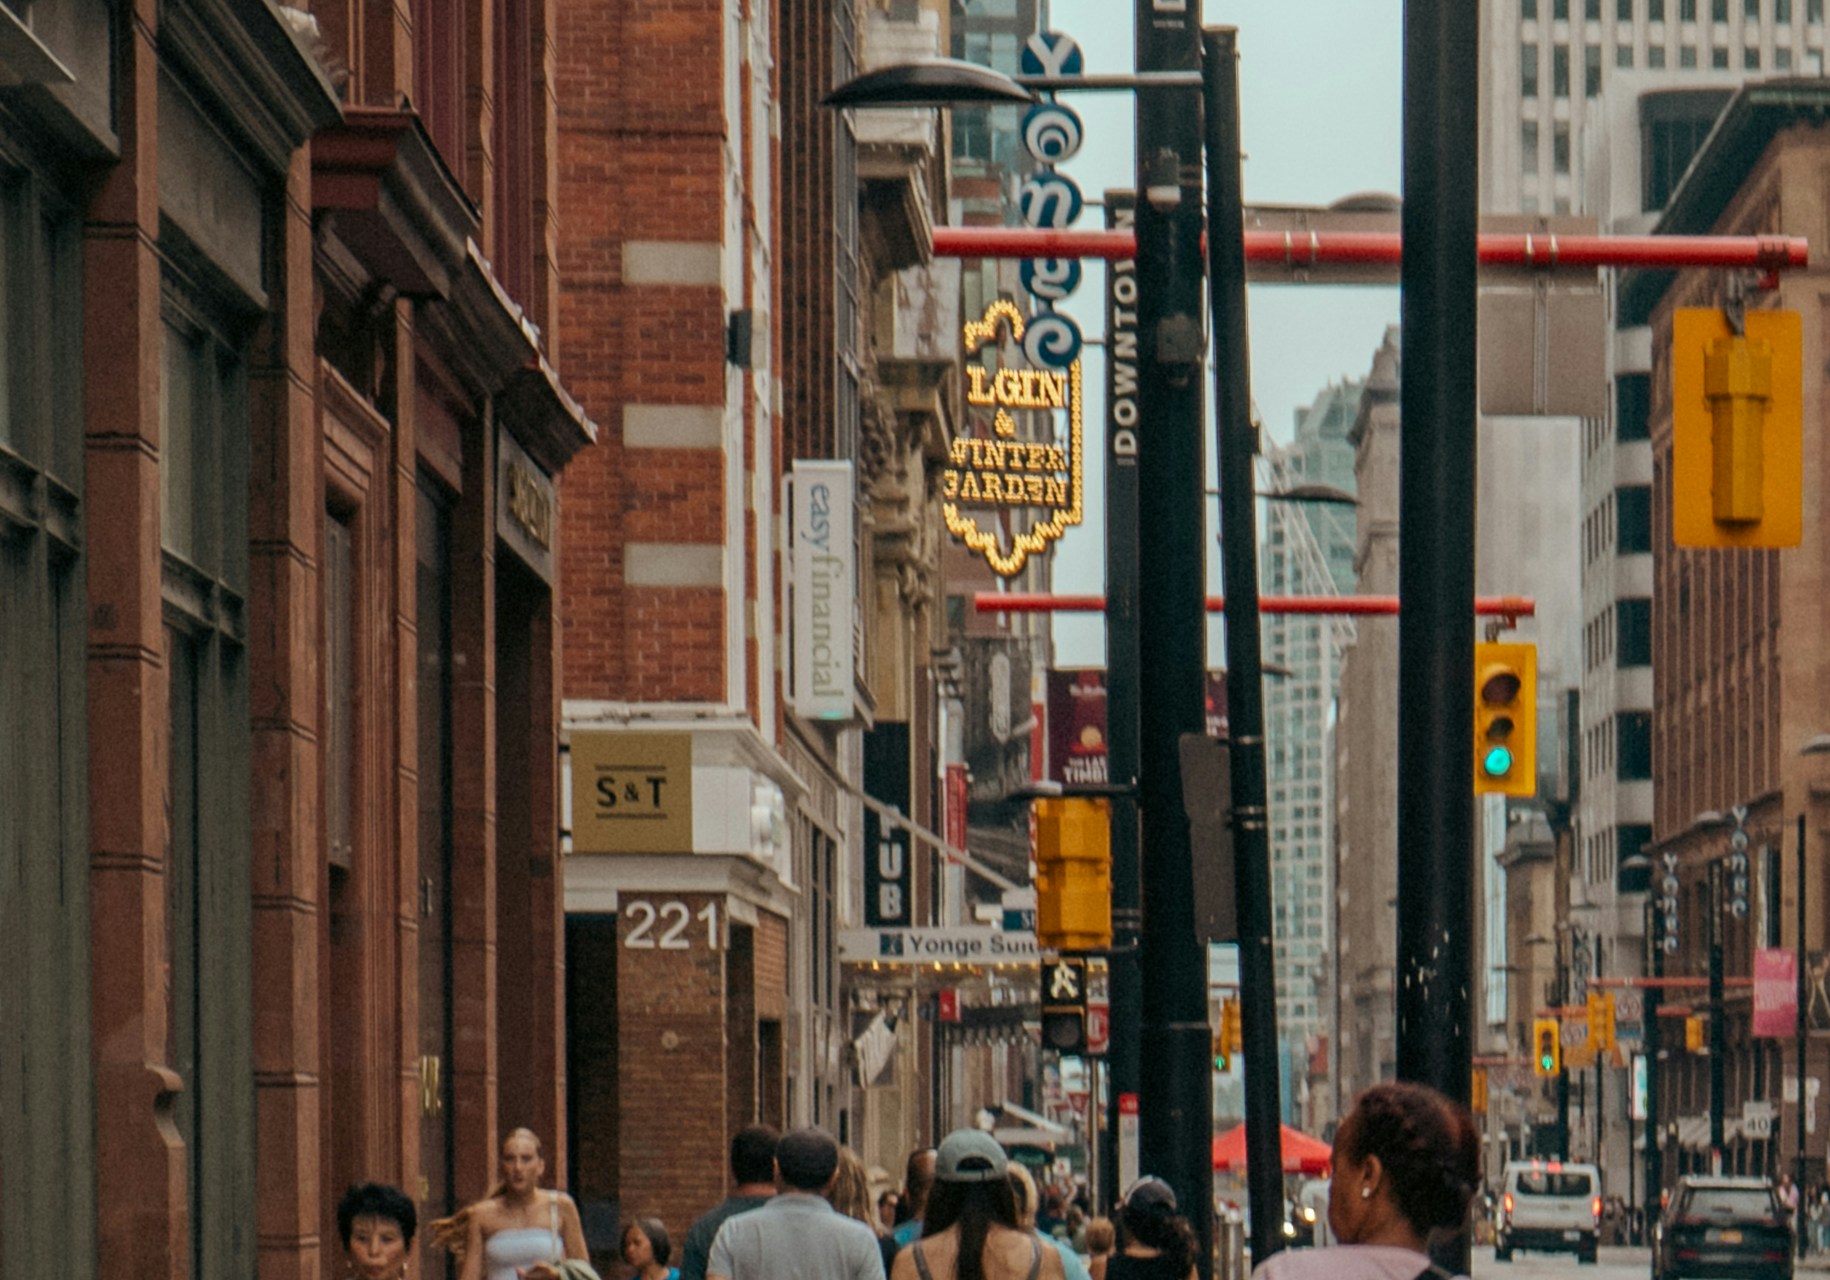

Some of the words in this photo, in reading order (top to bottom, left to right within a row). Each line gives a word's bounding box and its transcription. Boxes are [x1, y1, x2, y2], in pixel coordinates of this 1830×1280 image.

[596, 776, 617, 808] S
[624, 783, 639, 802] &
[646, 776, 667, 808] T
[624, 900, 718, 950] 221
[908, 935, 983, 957] Yonge
